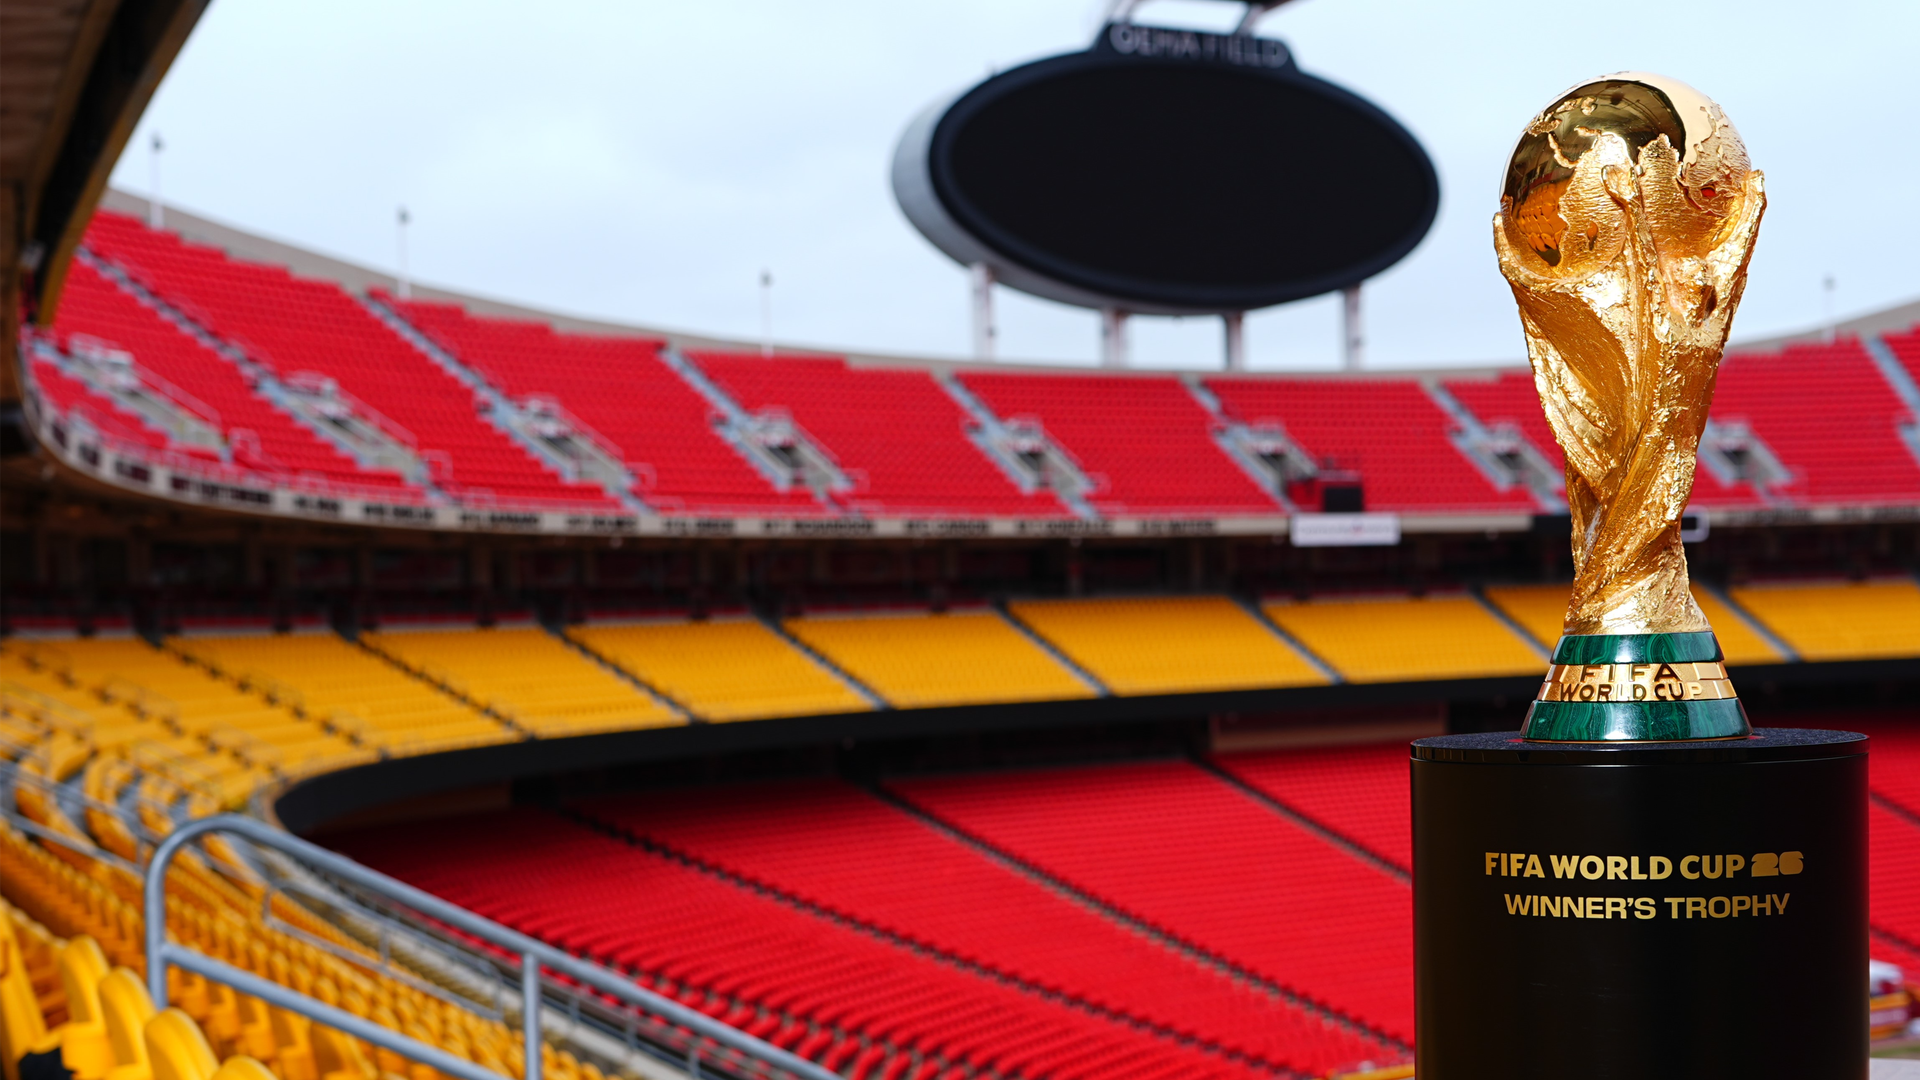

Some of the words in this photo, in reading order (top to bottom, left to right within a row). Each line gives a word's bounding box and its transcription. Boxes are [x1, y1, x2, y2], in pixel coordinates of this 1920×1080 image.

[1202, 33, 1289, 69] FIELD
[1580, 663, 1682, 683] FIFA
[1560, 682, 1647, 701] WORLD
[1653, 681, 1703, 700] CUP
[1485, 852, 1546, 878] FIFA
[1549, 854, 1674, 881] WORLD
[1679, 854, 1746, 880] CUP
[1751, 850, 1804, 878] 26
[1503, 893, 1657, 919] WINNER'S
[1664, 892, 1791, 919] TROPHY
